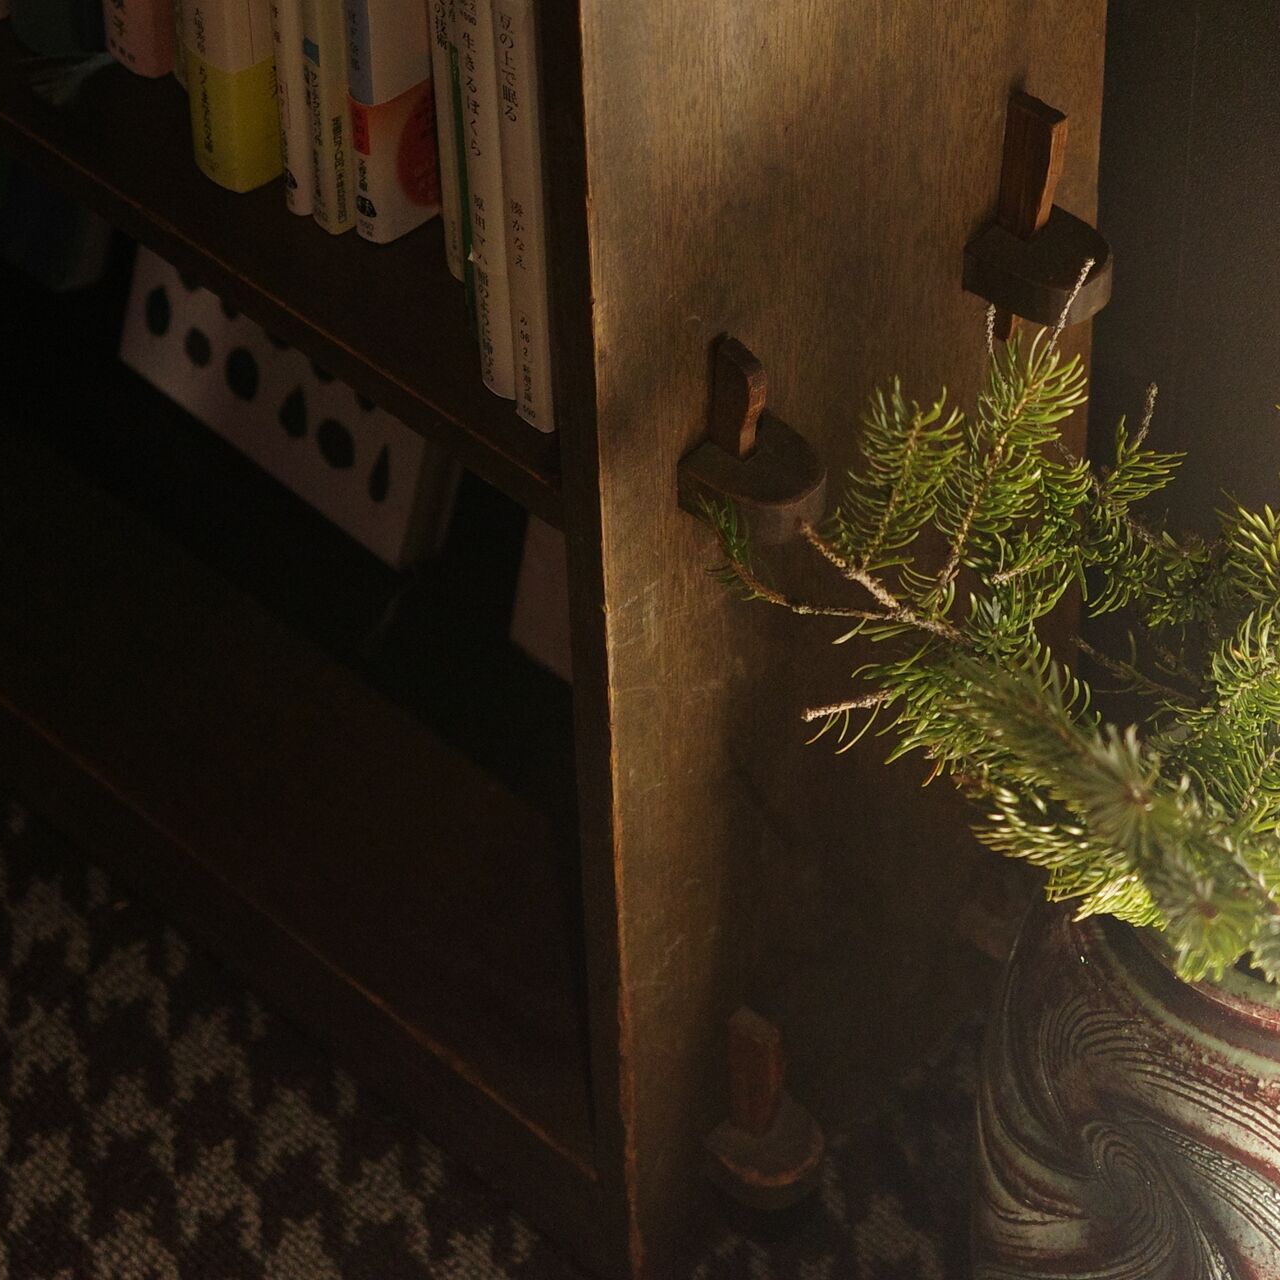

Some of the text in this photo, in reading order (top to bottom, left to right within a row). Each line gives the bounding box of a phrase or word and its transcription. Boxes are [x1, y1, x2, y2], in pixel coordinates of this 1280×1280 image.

[463, 30, 484, 159] 生きるぼくら
[498, 14, 520, 123] 豆の上で眠る
[473, 195, 489, 270] 原田マハ
[509, 201, 528, 272] 湊かなえ
